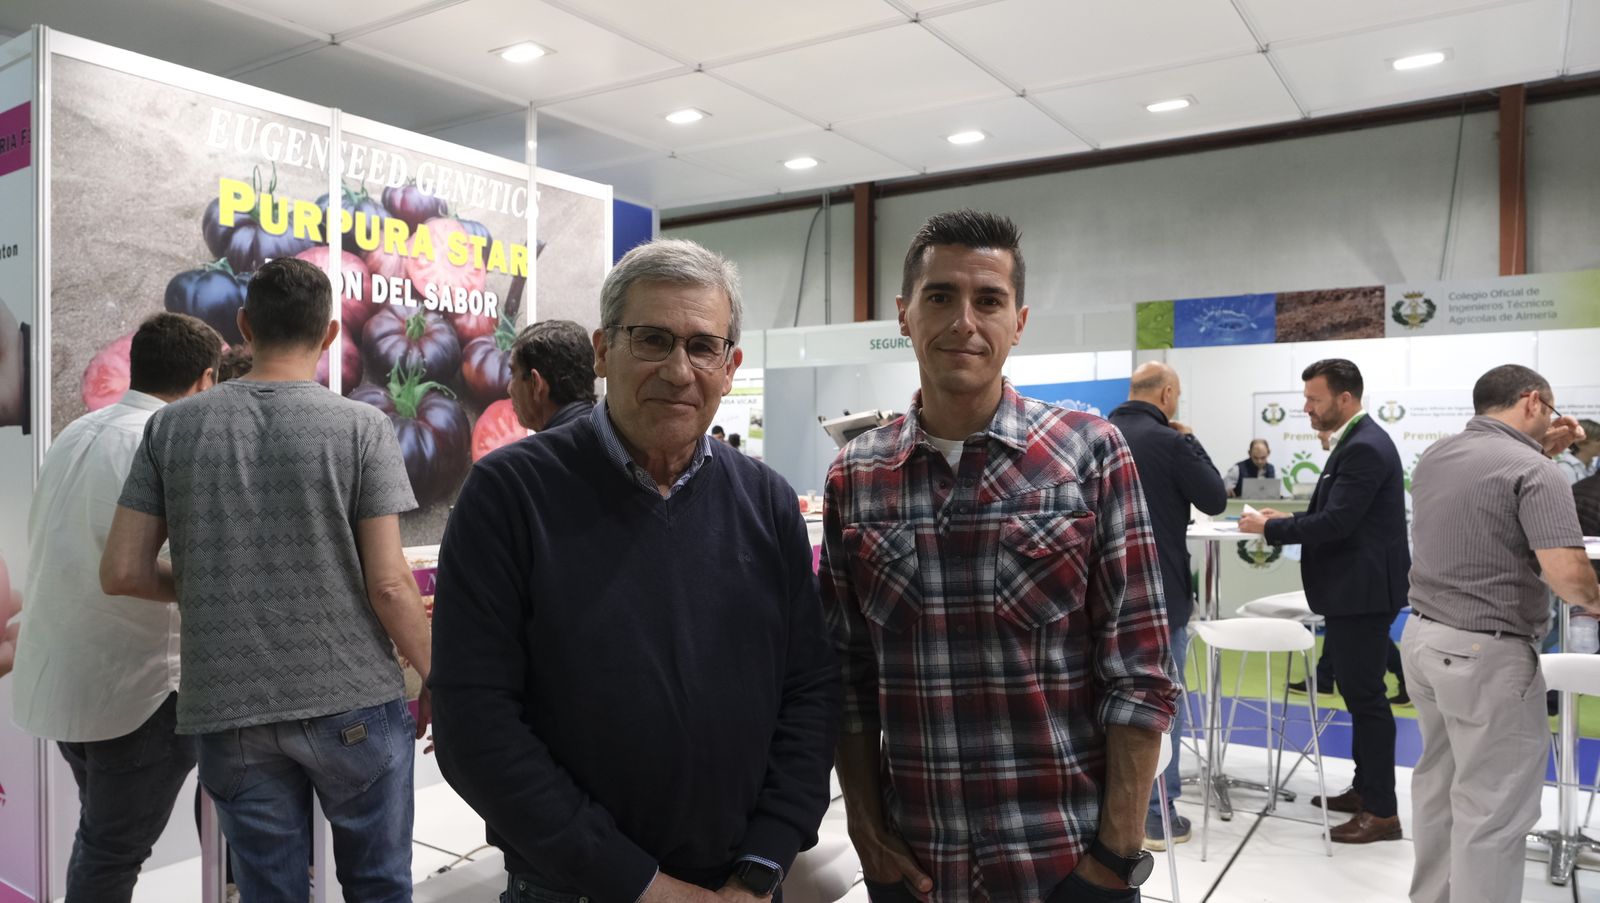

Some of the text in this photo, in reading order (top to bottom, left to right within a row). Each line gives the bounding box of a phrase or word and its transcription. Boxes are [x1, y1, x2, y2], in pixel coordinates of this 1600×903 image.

[416, 161, 541, 219] GENETICS
[219, 177, 528, 278] PURPURA STAR
[372, 274, 417, 308] DEL
[424, 282, 498, 319] SABOR
[1448, 287, 1540, 301] Colegio Oficial de
[1448, 302, 1503, 313] Ingenieros
[1499, 312, 1513, 322] de
